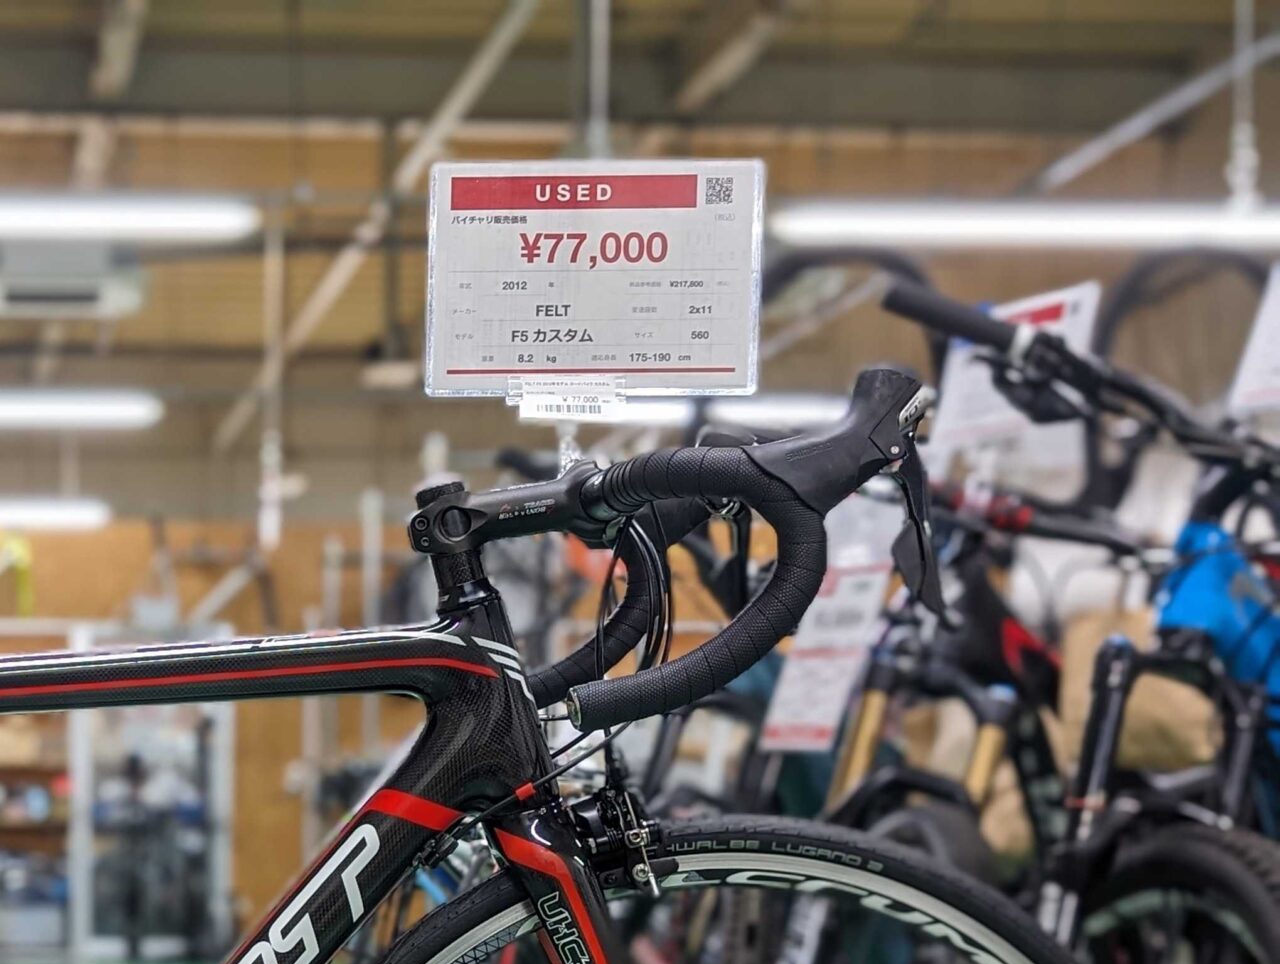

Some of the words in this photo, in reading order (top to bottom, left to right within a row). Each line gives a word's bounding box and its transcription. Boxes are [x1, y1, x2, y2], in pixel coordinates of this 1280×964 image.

[535, 183, 613, 202] USED
[451, 215, 528, 225] バイチャリ販売価格
[519, 231, 669, 269] ¥77,000
[501, 280, 528, 291] 2012
[535, 304, 572, 317] FELT
[688, 305, 713, 315] 2x11
[511, 330, 529, 343] F5
[532, 328, 594, 343] カスタム
[690, 330, 710, 340] 560
[517, 353, 534, 363] 8.2
[546, 354, 557, 364] kg
[628, 352, 671, 363] 175-190
[677, 354, 692, 362] cm
[654, 839, 760, 854] WALBE
[771, 841, 863, 866] LUGANO
[866, 859, 884, 874] 2
